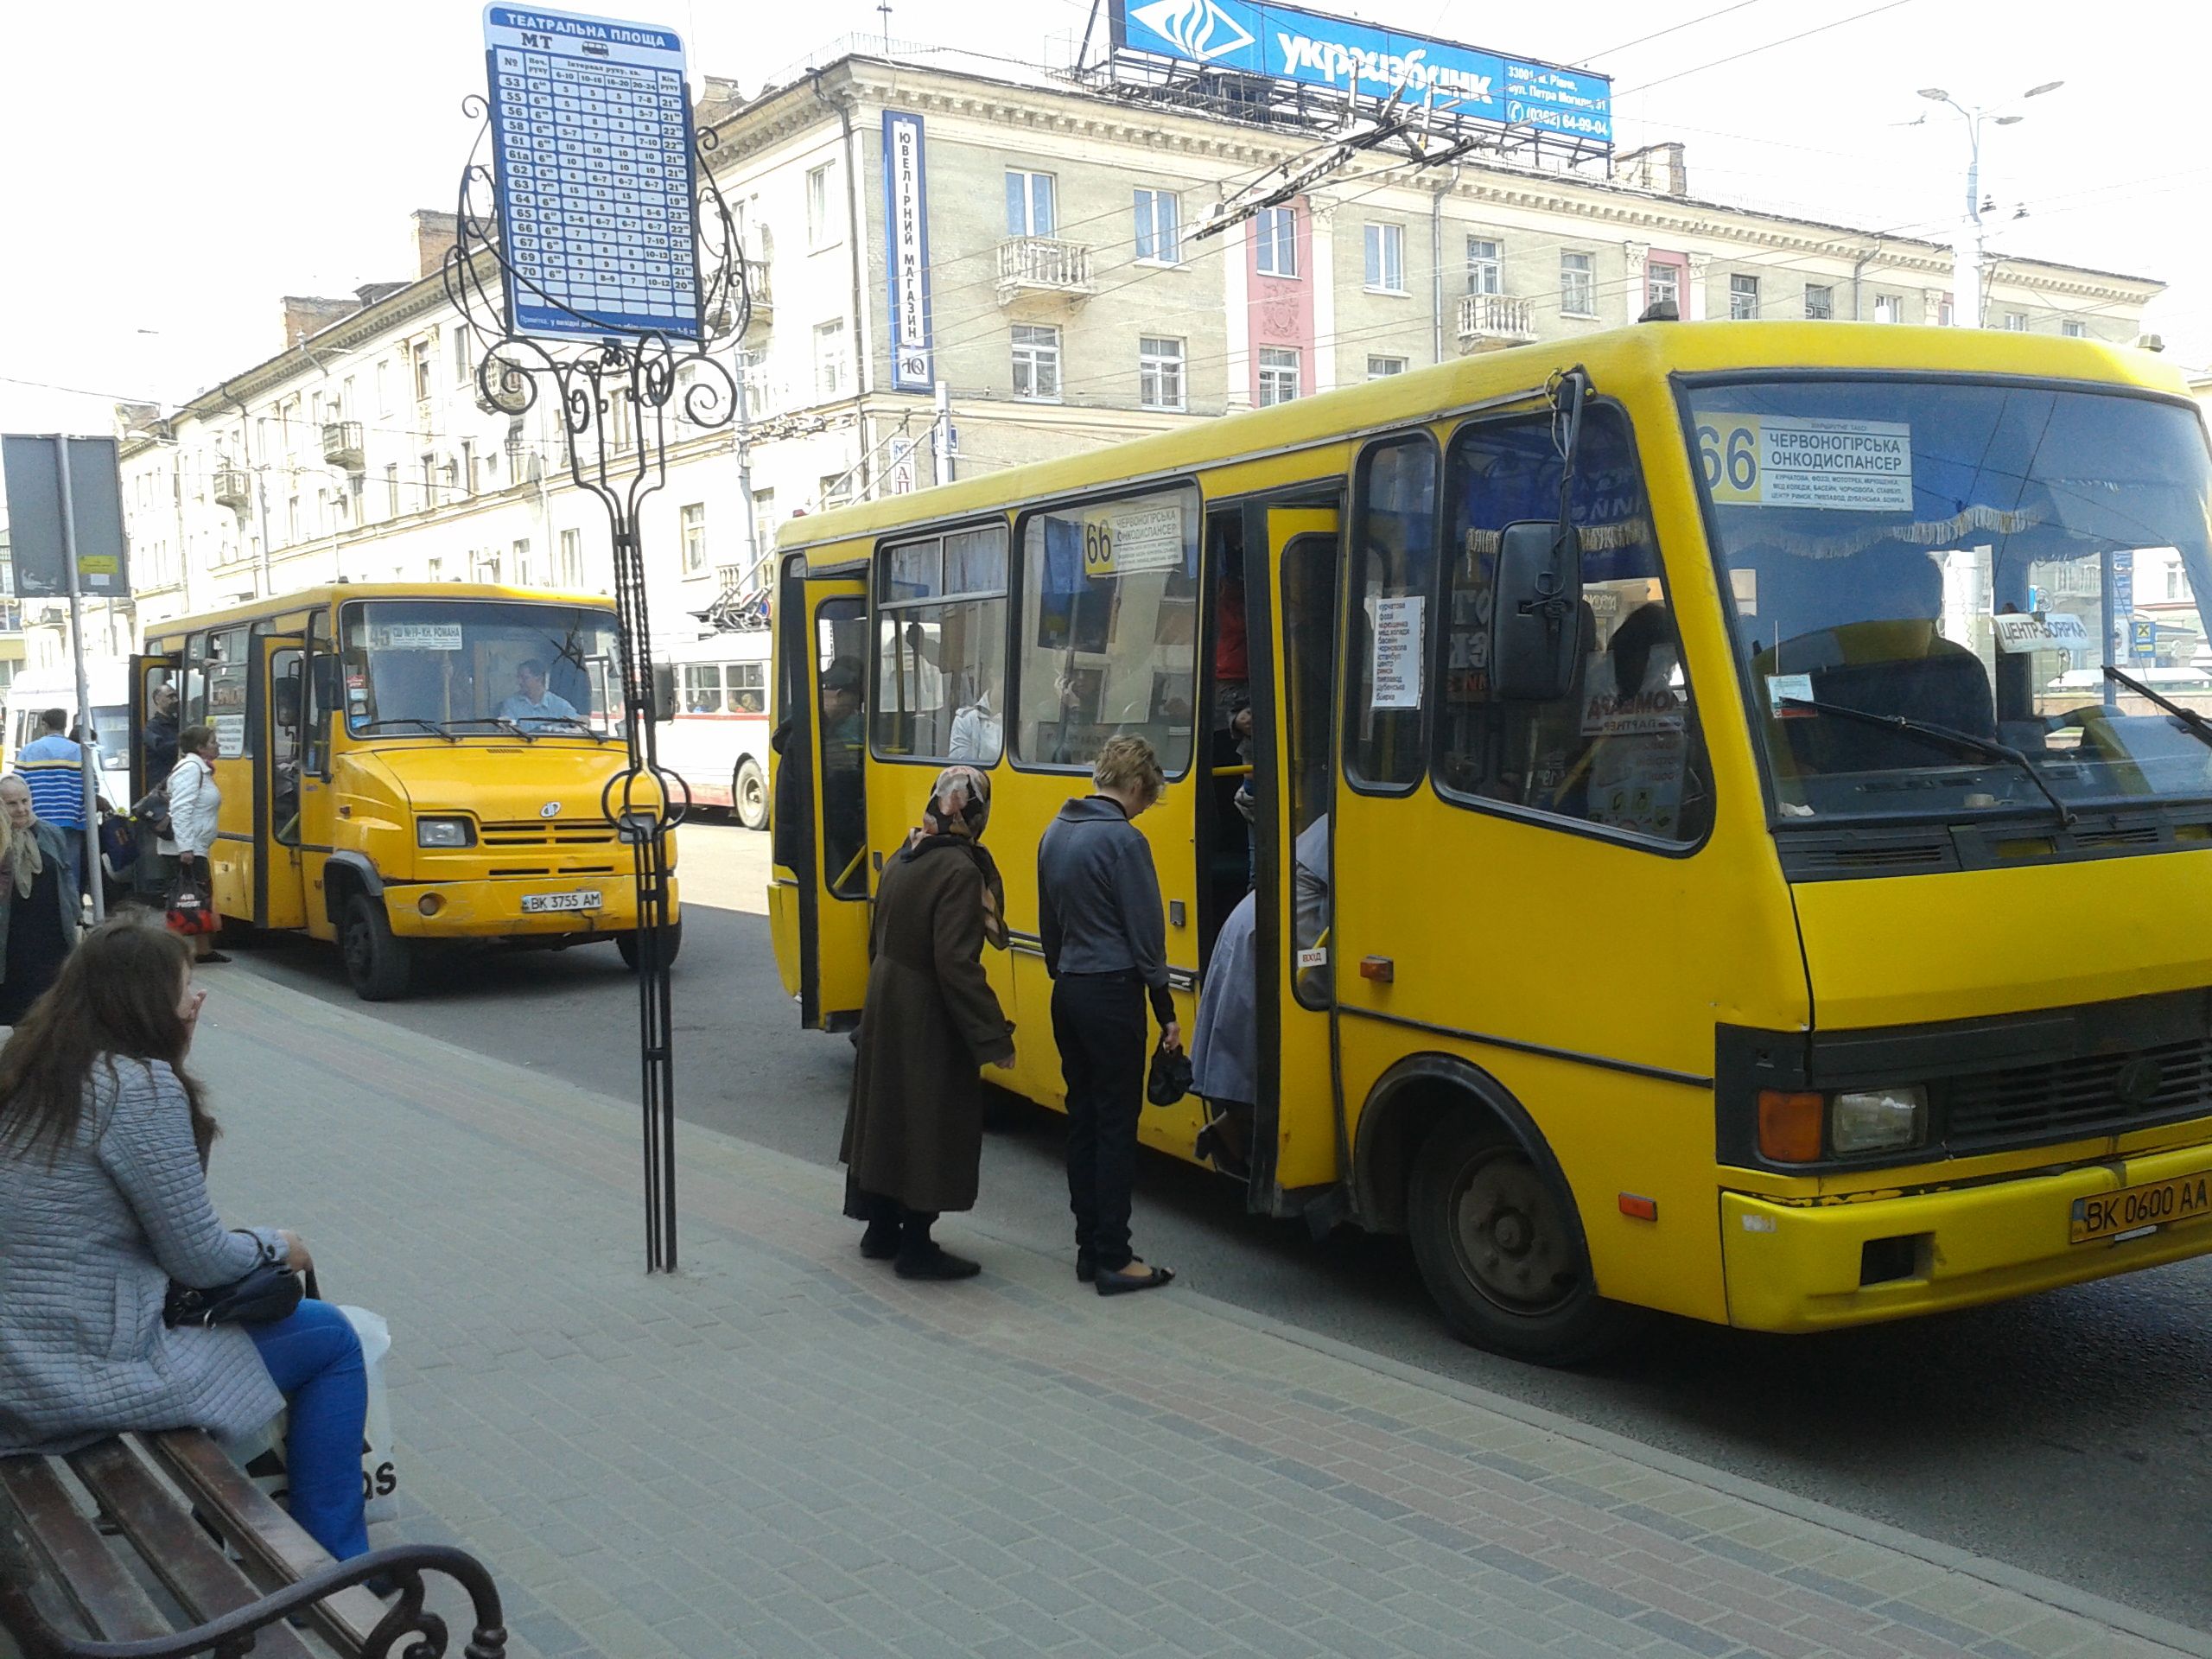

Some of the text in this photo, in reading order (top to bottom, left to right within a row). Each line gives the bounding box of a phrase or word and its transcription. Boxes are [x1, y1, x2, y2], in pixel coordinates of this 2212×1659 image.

[507, 13, 664, 48] ТЕАТРАЛЬНА ПЛОЩА
[521, 33, 553, 50] МТ
[505, 57, 518, 67] №
[505, 77, 520, 87] 53
[638, 95, 652, 104] 7-8
[507, 92, 522, 101] 55
[508, 106, 523, 117] 56
[510, 121, 524, 130] 58
[639, 137, 658, 146] 7-10
[512, 136, 524, 145] 61
[513, 165, 527, 175] 62
[514, 179, 529, 189] 63
[515, 194, 531, 204] 64
[517, 208, 531, 219] 65
[518, 223, 533, 232] 66
[899, 131, 918, 339] ЮВЕЛІРНИЙ МАГАЗИН
[519, 238, 533, 247] 67
[520, 252, 535, 262] 69
[522, 267, 536, 276] 70
[1769, 433, 1901, 454] ЧЕРВОНОГІРСЬКА
[1696, 425, 1757, 492] 66
[1771, 451, 1902, 471] ОНКОДИСПАНСЕР
[1086, 518, 1112, 564] 66
[2002, 620, 2088, 644] ЦЕНТР-БОЯРКА
[551, 894, 578, 908] 3755
[2125, 1185, 2174, 1224] 0600
